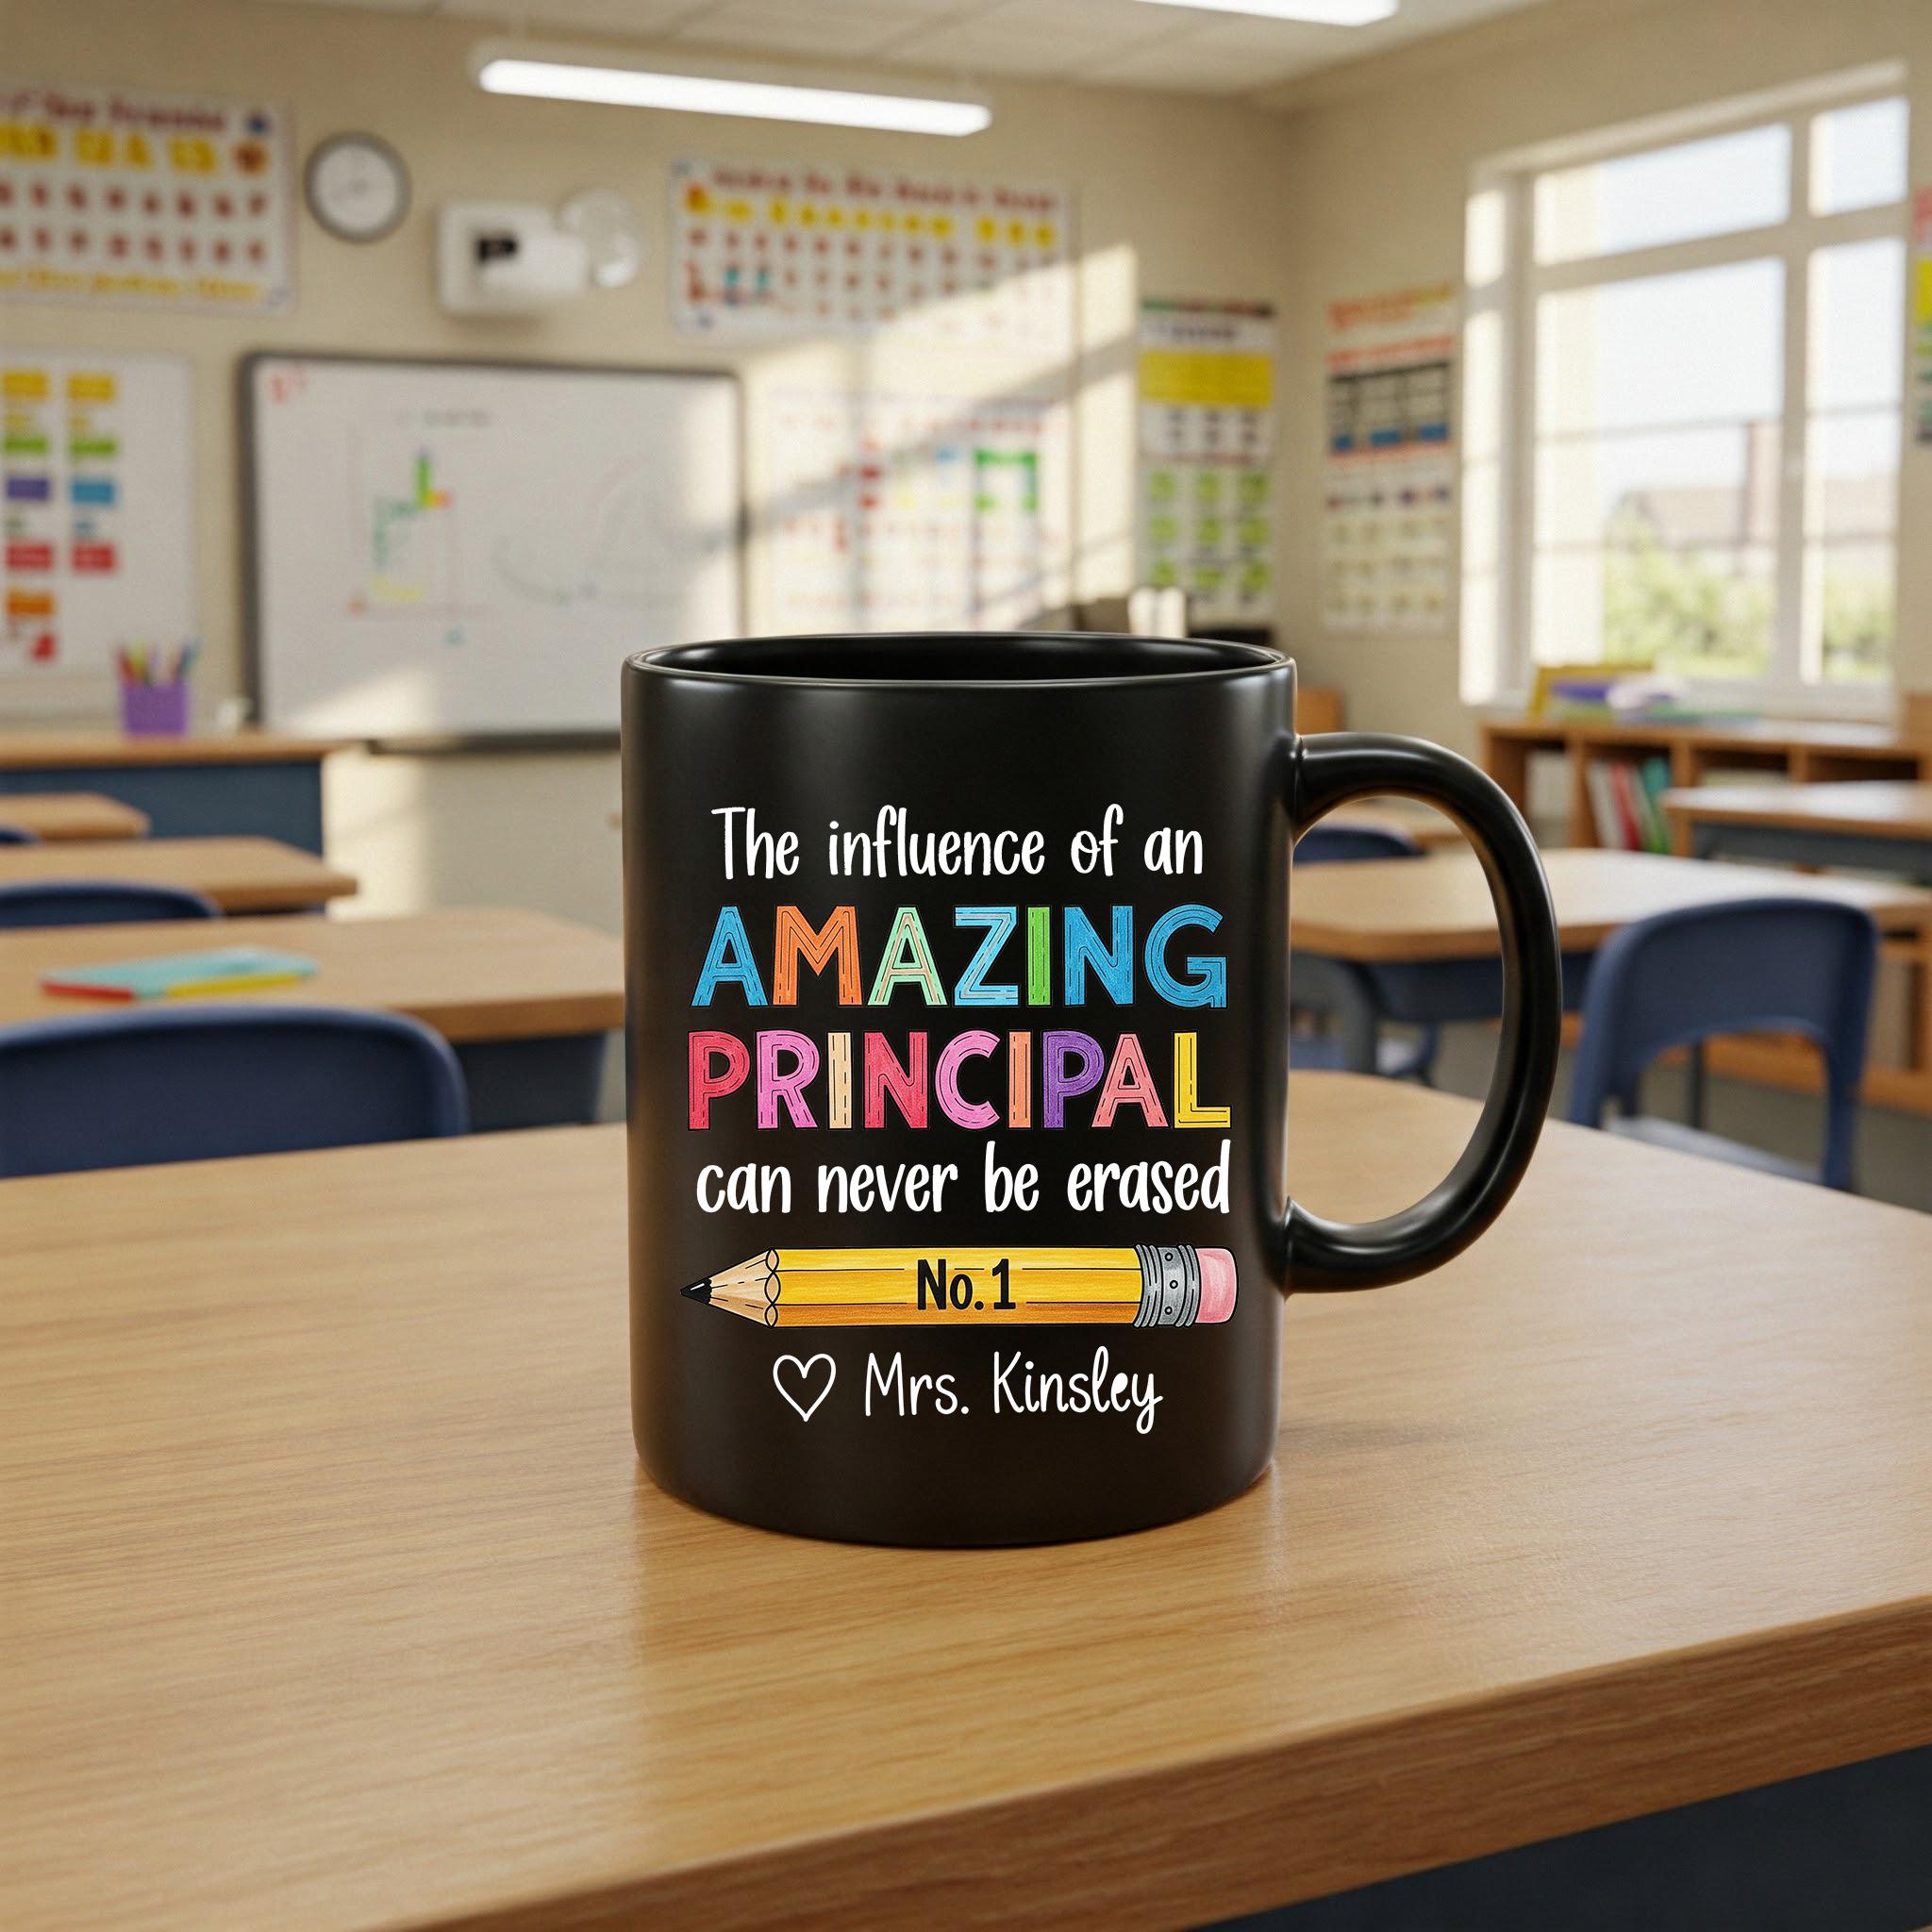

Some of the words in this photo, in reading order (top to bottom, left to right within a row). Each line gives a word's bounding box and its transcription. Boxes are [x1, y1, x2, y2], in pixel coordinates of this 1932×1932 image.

[711, 807, 799, 879] The
[829, 805, 1044, 877] influence
[1071, 804, 1124, 876] of
[1144, 827, 1202, 874] an
[691, 905, 1226, 1008] AMAZING
[689, 1030, 1230, 1128] PRINCIPAL
[697, 1163, 791, 1213] can
[818, 1164, 958, 1212] never
[985, 1141, 1039, 1212] be
[1068, 1140, 1231, 1214] erased
[918, 1259, 1015, 1309] No.1
[865, 1352, 969, 1416] Mrs.
[994, 1346, 1163, 1434] Kinsley
